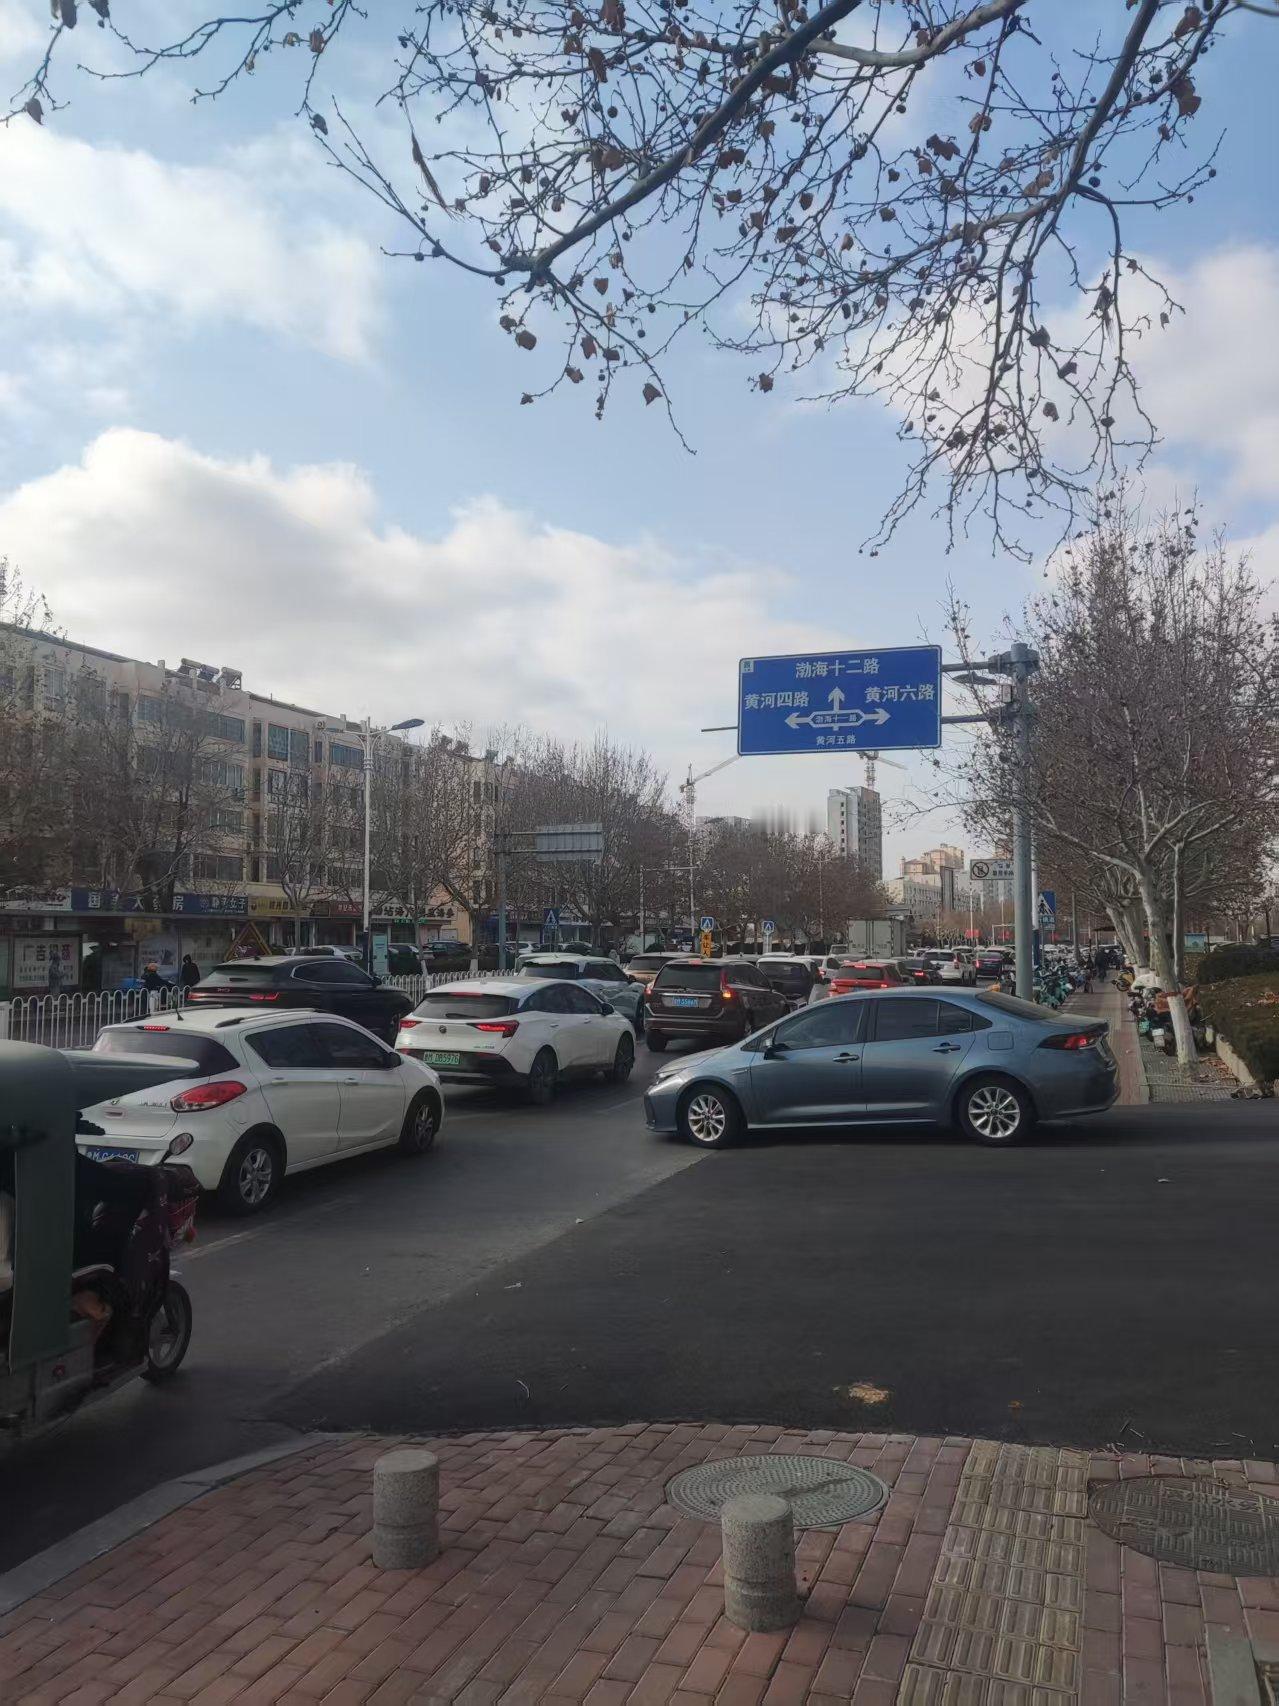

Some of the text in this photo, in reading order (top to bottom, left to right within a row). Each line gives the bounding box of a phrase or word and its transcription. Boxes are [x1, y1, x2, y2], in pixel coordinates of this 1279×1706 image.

[796, 658, 880, 679] 渤海十二路
[744, 691, 809, 710] 黄河四路
[864, 684, 935, 704] 黄河六路
[816, 734, 856, 746] 黄河五路
